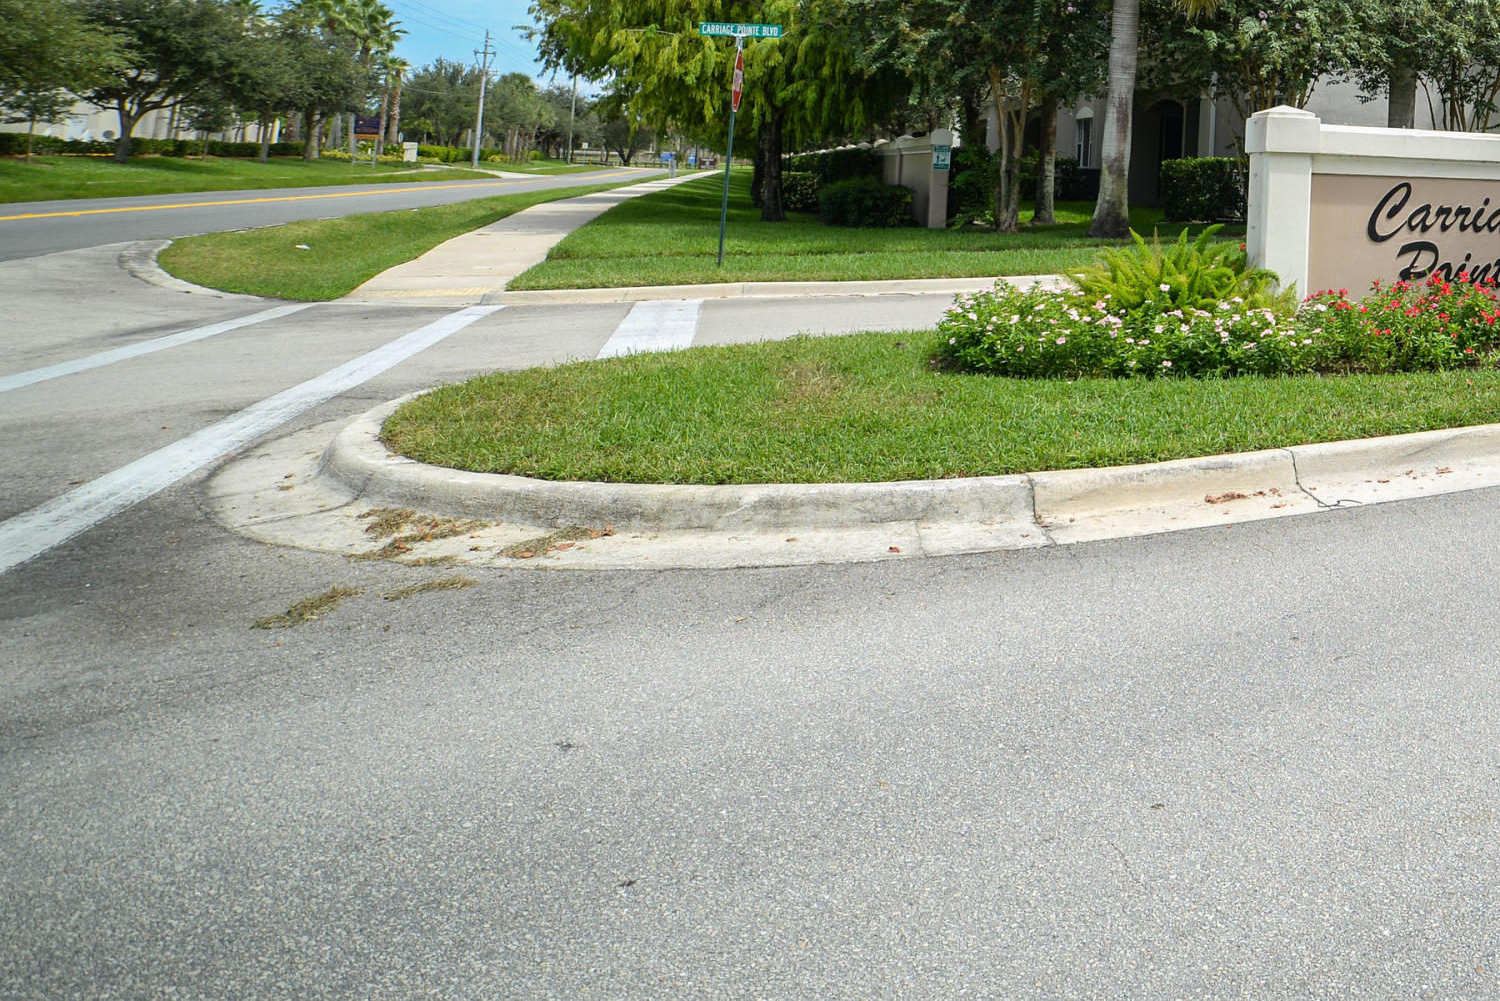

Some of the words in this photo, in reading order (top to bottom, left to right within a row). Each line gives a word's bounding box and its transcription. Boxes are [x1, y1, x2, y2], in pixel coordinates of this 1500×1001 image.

[702, 24, 734, 34] CARRIAGE
[737, 25, 759, 35] POINTE
[762, 26, 779, 36] BLVD
